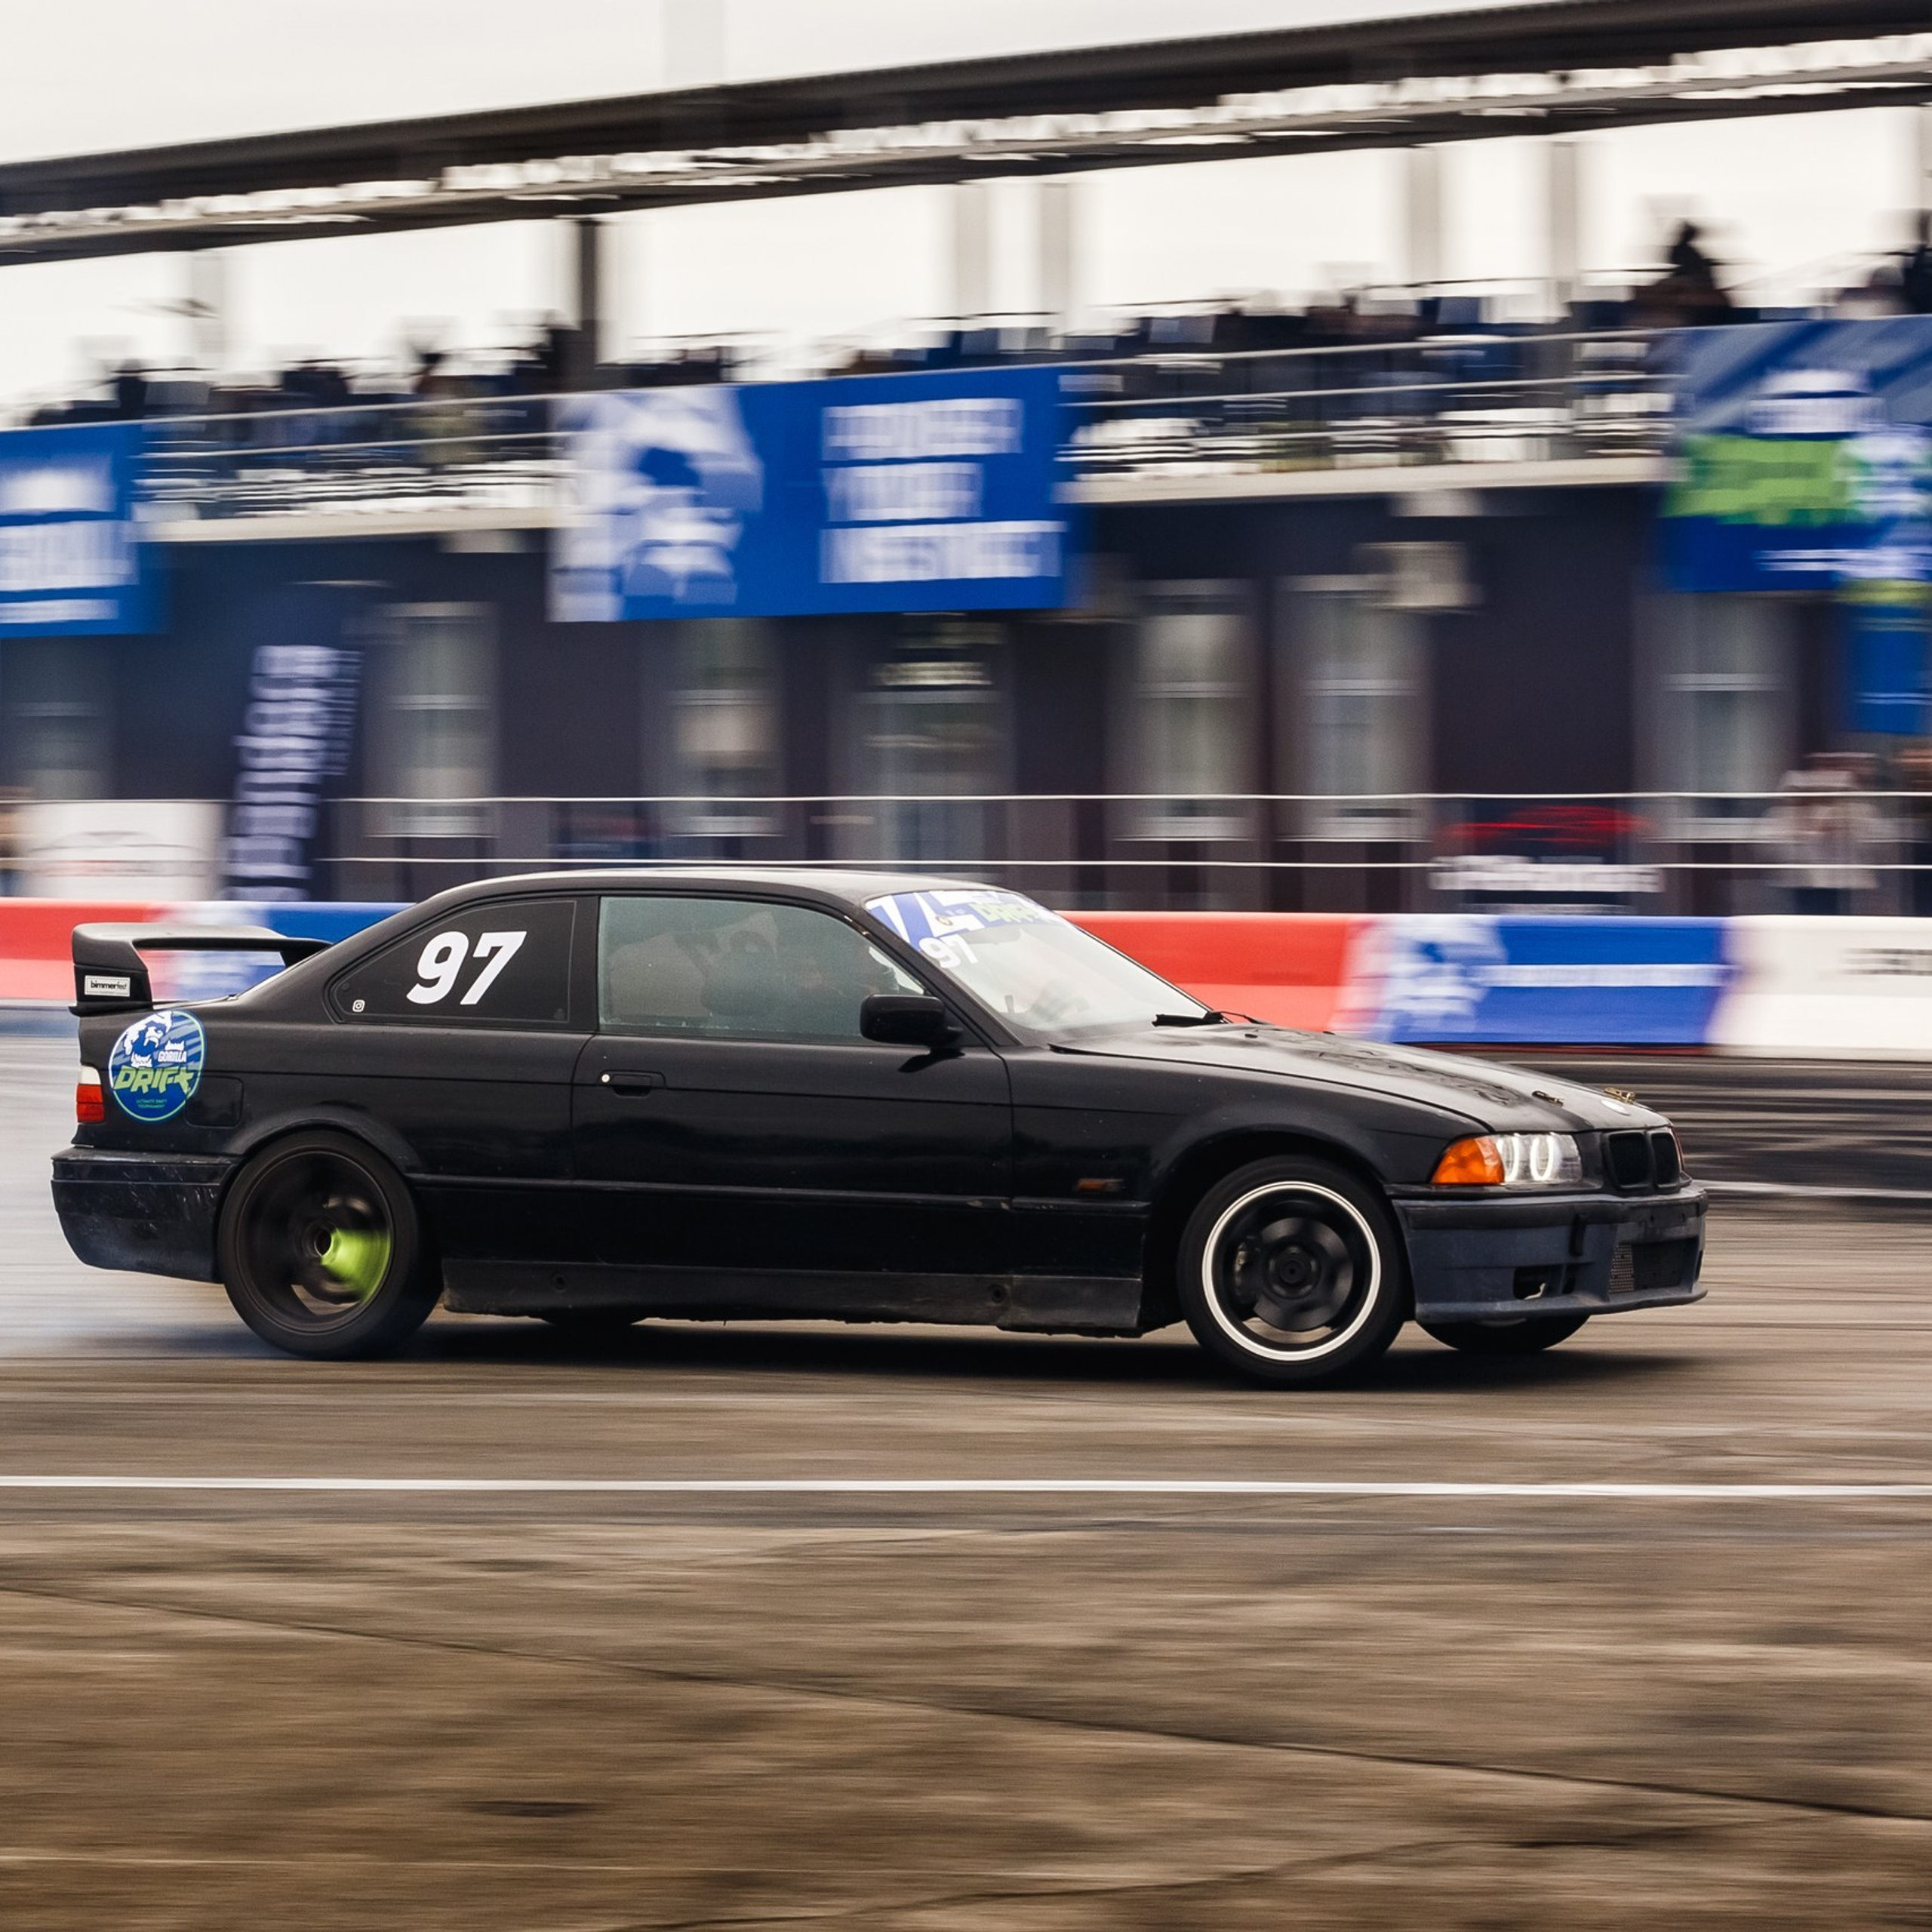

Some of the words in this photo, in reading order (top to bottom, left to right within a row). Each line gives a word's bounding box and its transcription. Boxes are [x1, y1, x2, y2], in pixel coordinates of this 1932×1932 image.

[919, 934, 979, 968] 97
[407, 931, 527, 1004] 97
[158, 1051, 187, 1063] GORILLA
[113, 1065, 194, 1094] DRIFT
